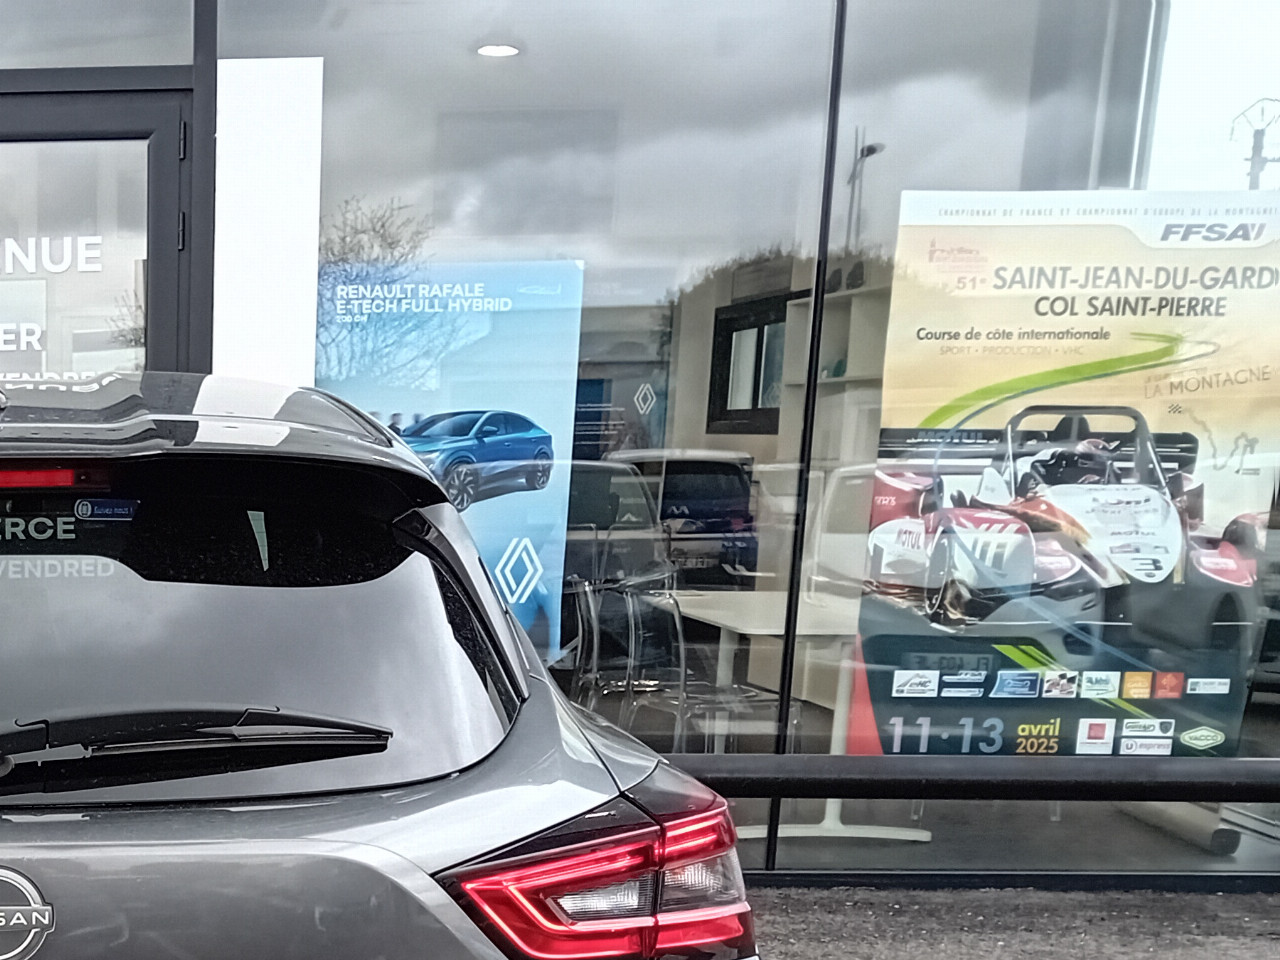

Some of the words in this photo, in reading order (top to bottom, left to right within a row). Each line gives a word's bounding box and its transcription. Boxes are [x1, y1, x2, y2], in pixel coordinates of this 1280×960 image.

[336, 284, 415, 299] RENAULT
[419, 283, 485, 298] RAFALE
[336, 300, 398, 314] E-TECH
[401, 299, 444, 313] FULL
[447, 297, 513, 312] HYBRID
[1034, 296, 1079, 317] COL
[1086, 296, 1228, 317] SAINT-PIERRE
[916, 327, 961, 341] Course
[964, 326, 982, 340] de
[986, 328, 1014, 341] côte
[1017, 326, 1111, 340] internationale
[939, 345, 972, 355] SPORT
[982, 345, 1051, 354] PRODUCTION
[1169, 364, 1271, 395] MONTAGNE
[1017, 717, 1061, 736] avril
[1015, 738, 1059, 753] 2025
